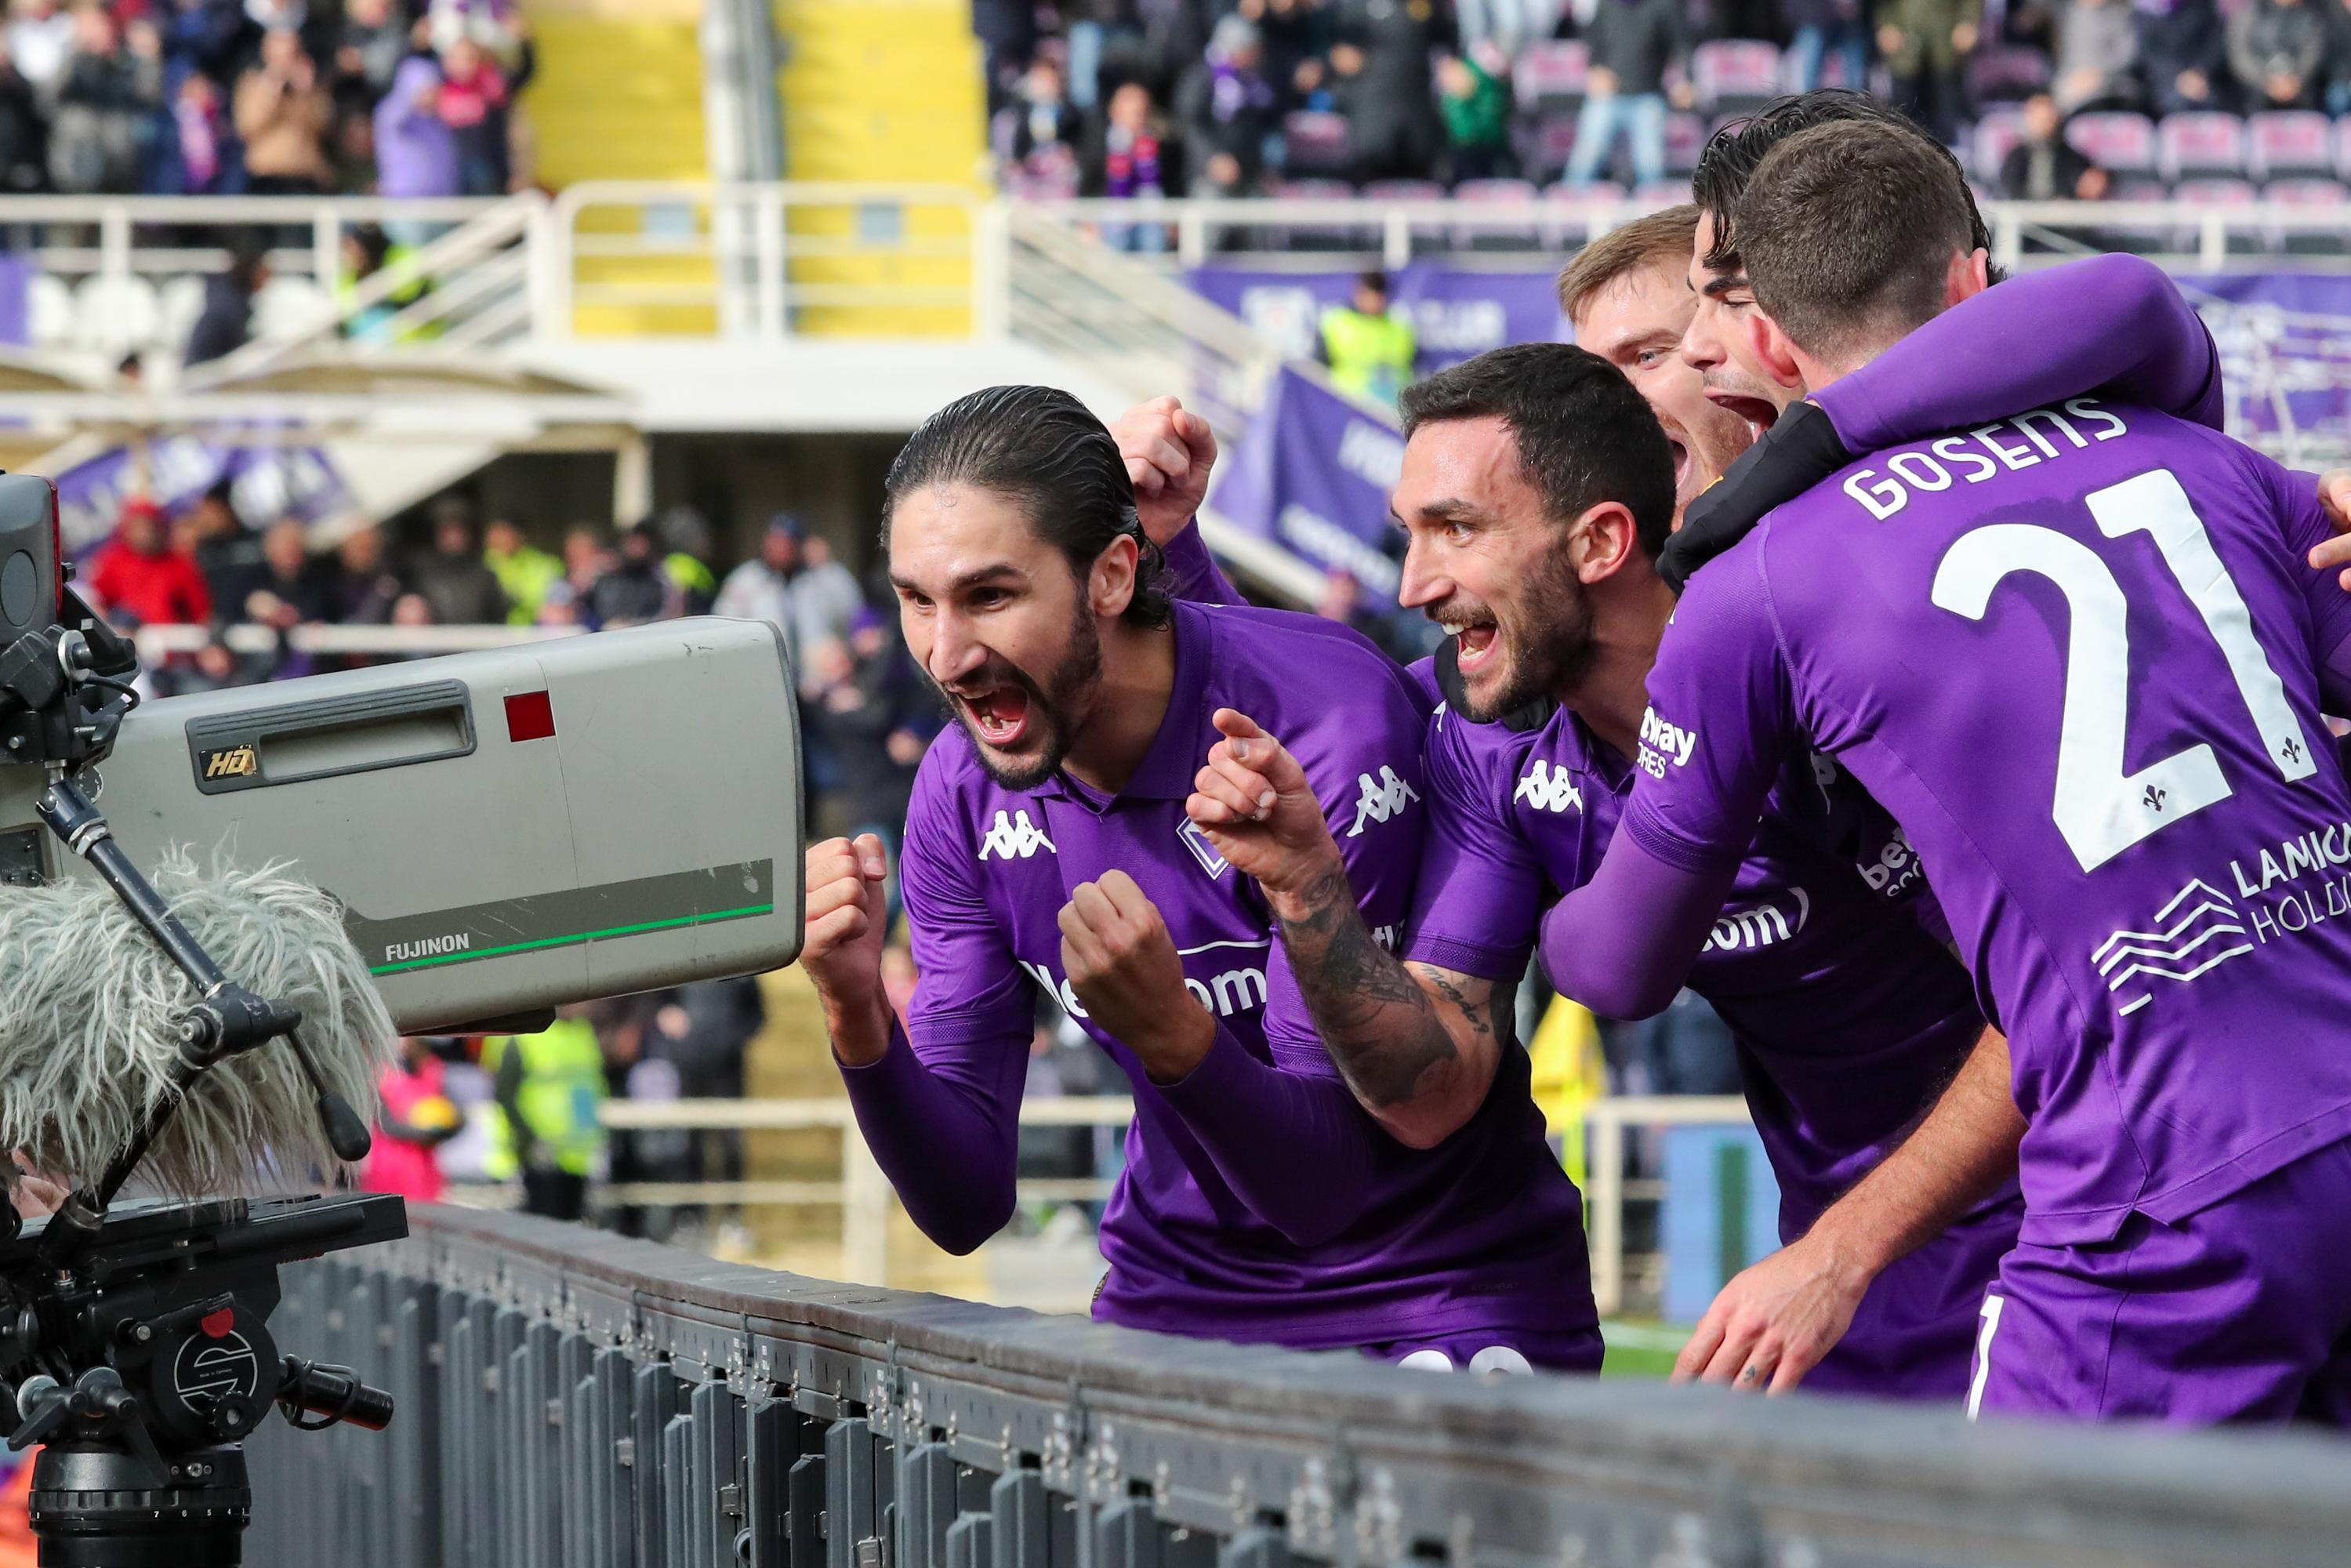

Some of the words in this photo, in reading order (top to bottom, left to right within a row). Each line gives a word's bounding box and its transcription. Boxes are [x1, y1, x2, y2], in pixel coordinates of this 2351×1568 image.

[1843, 397, 2128, 521] GOSENS
[1931, 468, 2318, 874] 21
[205, 749, 253, 778] HD
[385, 932, 470, 962] FUJINON
